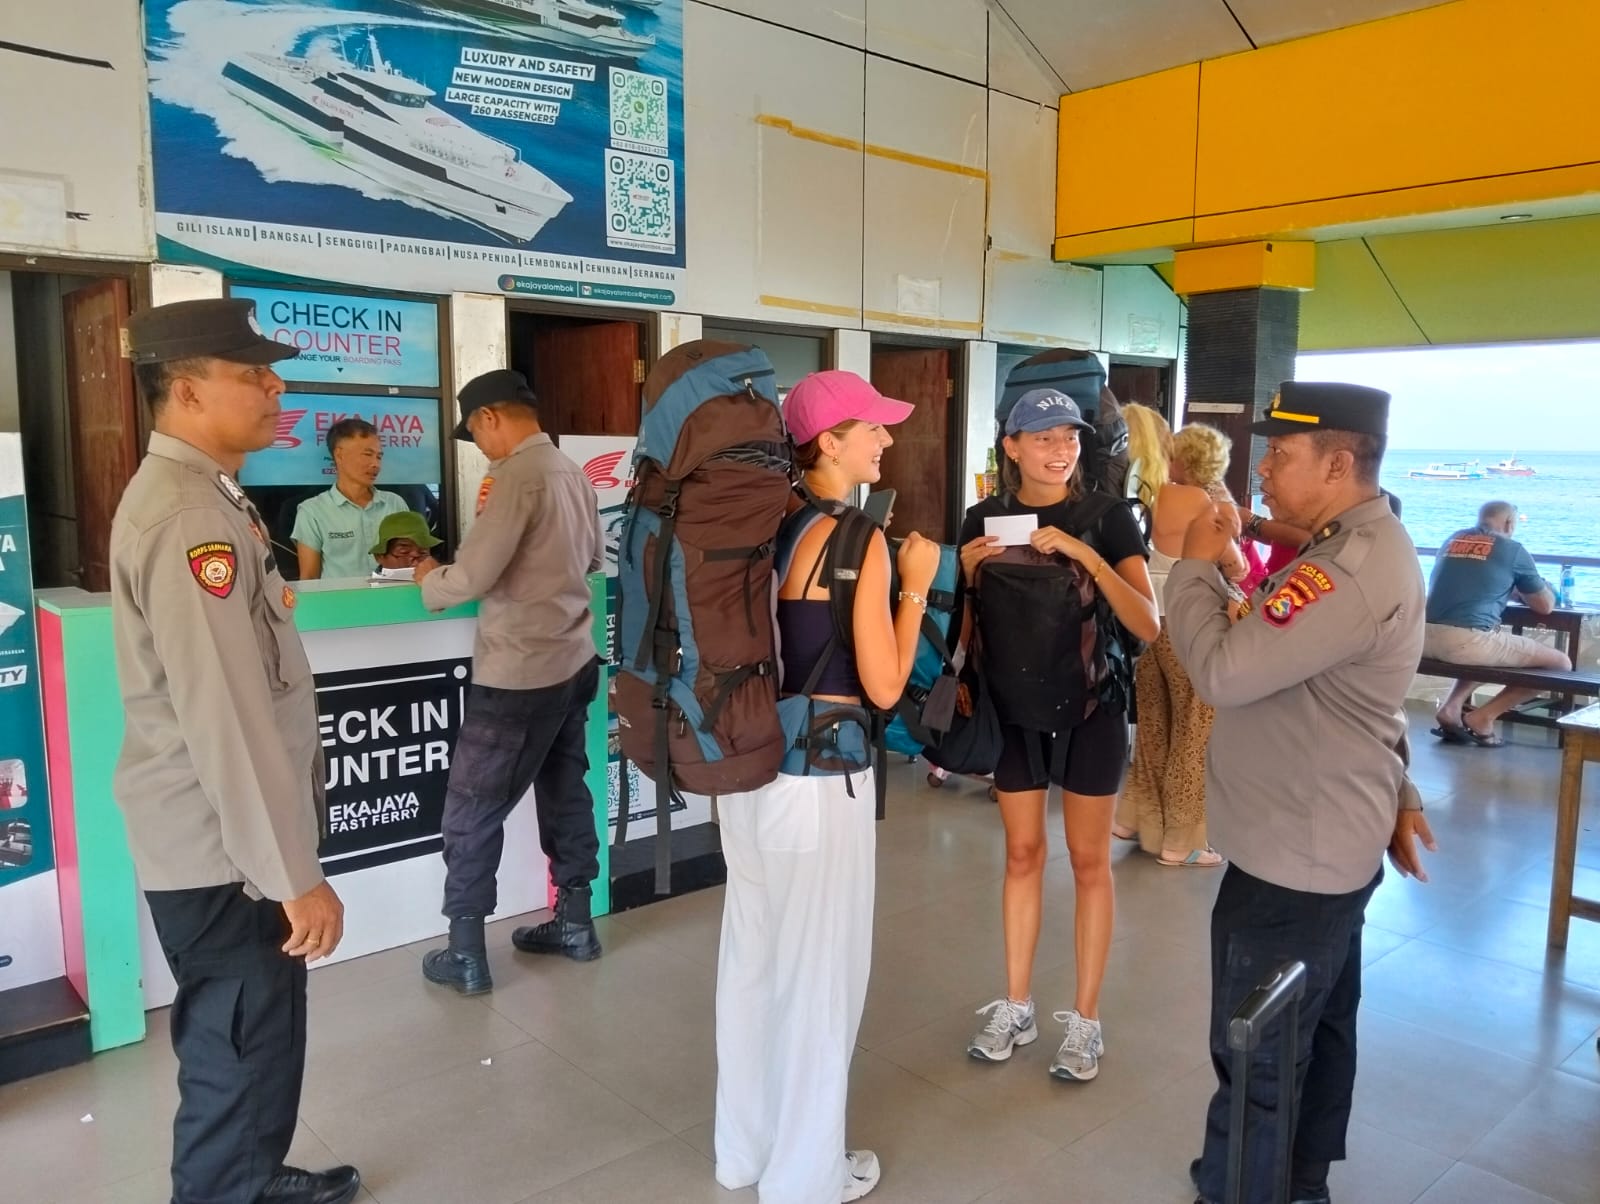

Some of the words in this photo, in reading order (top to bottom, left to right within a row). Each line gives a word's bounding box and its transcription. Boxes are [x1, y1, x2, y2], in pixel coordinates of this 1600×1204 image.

[463, 50, 516, 67] LUXURY
[518, 58, 546, 72] AND
[549, 63, 594, 78] SAFETY
[455, 71, 482, 84] NEW
[484, 76, 531, 91] MODERN
[534, 83, 571, 97] DESIGN
[447, 91, 481, 104] LARGE
[483, 95, 531, 110] CAPACITY
[533, 103, 559, 114] WITH
[473, 106, 492, 115] 260
[494, 108, 555, 124] PASSENGERS
[177, 221, 202, 234] GILI
[206, 224, 250, 238] ISLAND
[260, 230, 314, 244] BANGSAL
[325, 235, 378, 250] SENGGIGI
[386, 242, 446, 257] PADANGBAI
[453, 249, 479, 260] NUSA
[482, 252, 517, 265] PENIDA
[524, 257, 579, 271] LEMBONGAN
[585, 263, 628, 276] CENINGAN
[634, 269, 676, 281] SERANGAN
[270, 300, 370, 331] CHECK
[378, 309, 402, 333] IN
[273, 328, 403, 357] COUNTER
[319, 354, 341, 363] YOUR
[343, 356, 383, 365] BOARDING
[383, 358, 402, 367] PASS
[1036, 396, 1073, 411] NIKE
[318, 705, 399, 748] ECK
[410, 698, 449, 734] IN
[324, 740, 450, 791] UNTER
[329, 791, 420, 823] EKAJAYA
[330, 816, 368, 834] FAST
[372, 806, 420, 827] FERRY
